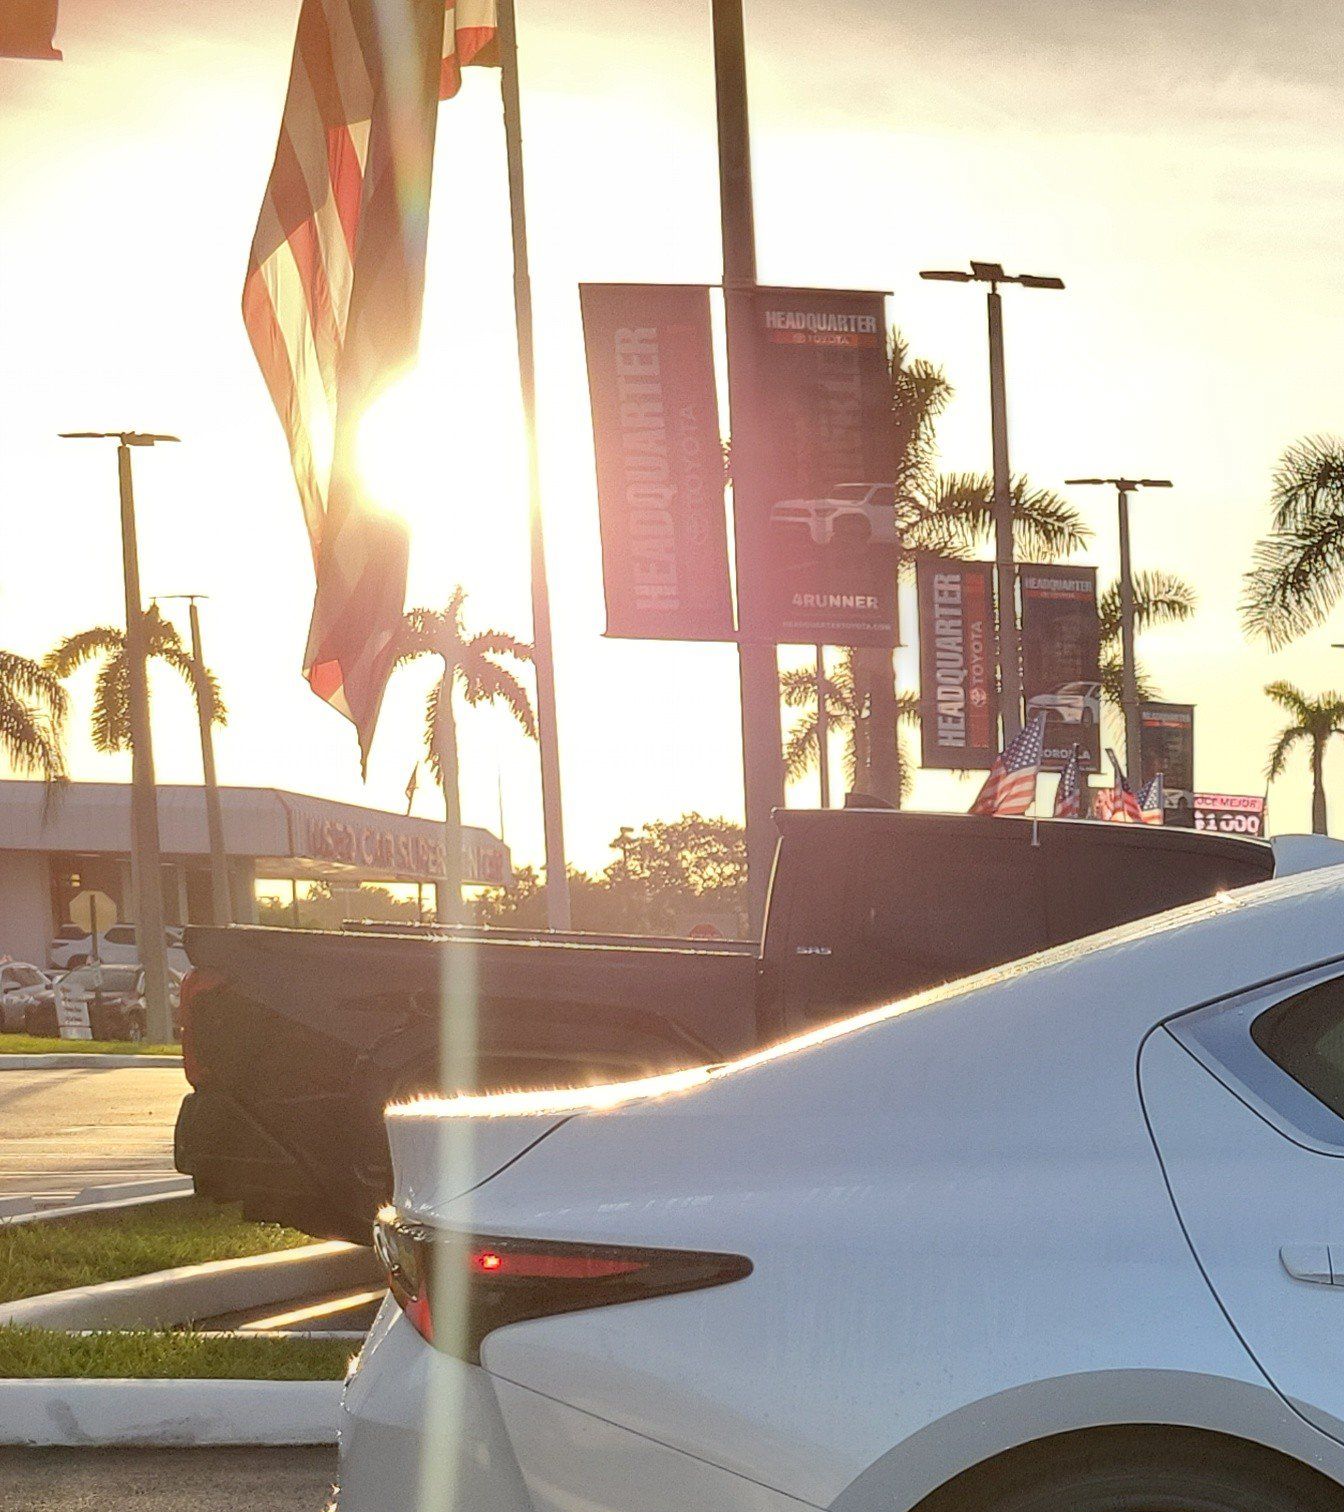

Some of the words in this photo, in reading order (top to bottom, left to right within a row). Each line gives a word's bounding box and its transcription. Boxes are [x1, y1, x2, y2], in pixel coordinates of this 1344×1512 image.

[764, 311, 878, 334] HEADQUARTER
[614, 326, 680, 610] HEADQUARTER
[791, 593, 879, 610] 4RUNNER
[1024, 575, 1092, 592] HEADQUARTER
[933, 574, 967, 747] HEADQUARTER
[970, 621, 986, 684] TOYOTA
